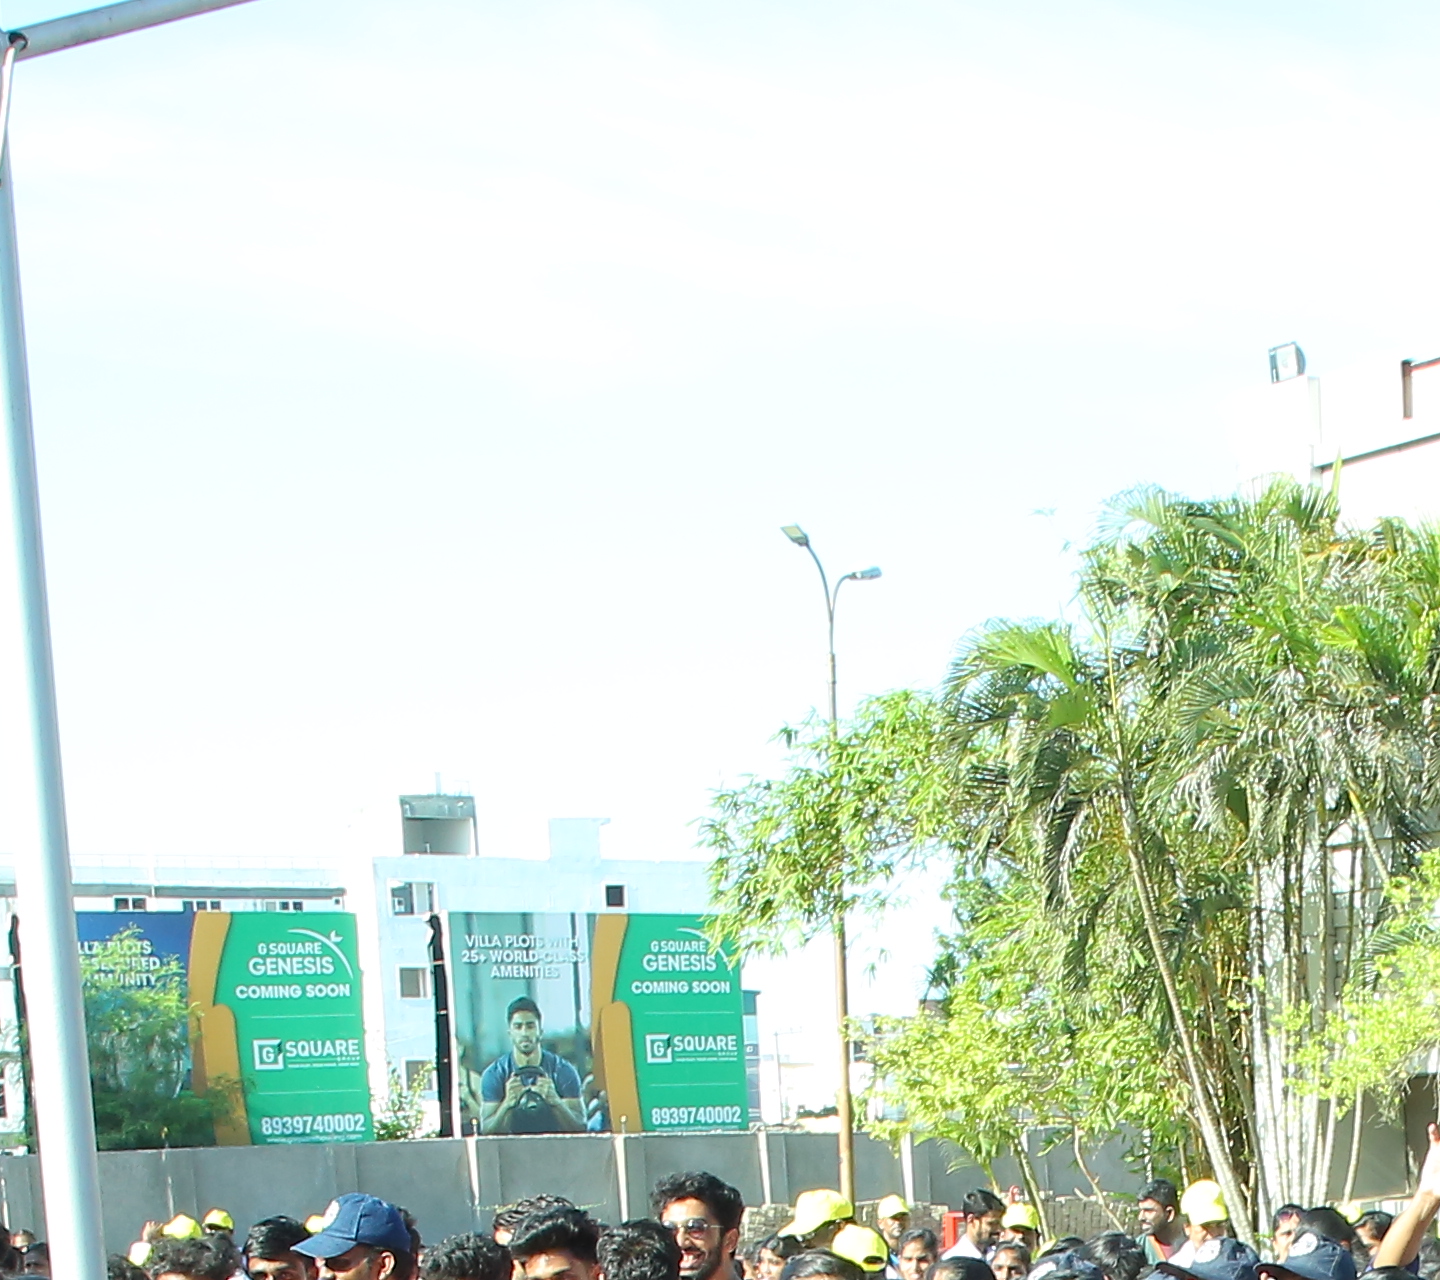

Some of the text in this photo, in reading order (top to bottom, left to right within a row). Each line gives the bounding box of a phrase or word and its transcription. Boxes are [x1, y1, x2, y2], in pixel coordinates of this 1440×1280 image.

[77, 941, 100, 955] LLA
[257, 941, 323, 956] G SQUARE
[464, 934, 502, 948] VILLA
[505, 934, 545, 948] PLOTS
[649, 939, 707, 953] G SQUARE
[461, 949, 586, 964] 25+ WORLD-CLASS
[641, 953, 718, 972] GENESIS
[247, 956, 335, 977] GENESIS
[490, 964, 560, 979] AMENITIES
[235, 983, 351, 1000] COMING SOON
[631, 980, 731, 995] COMING SOON
[285, 1038, 360, 1058] SQUARE
[673, 1034, 738, 1052] SQUARE
[652, 1107, 741, 1124] 8939740002
[261, 1114, 365, 1135] 8939740002
